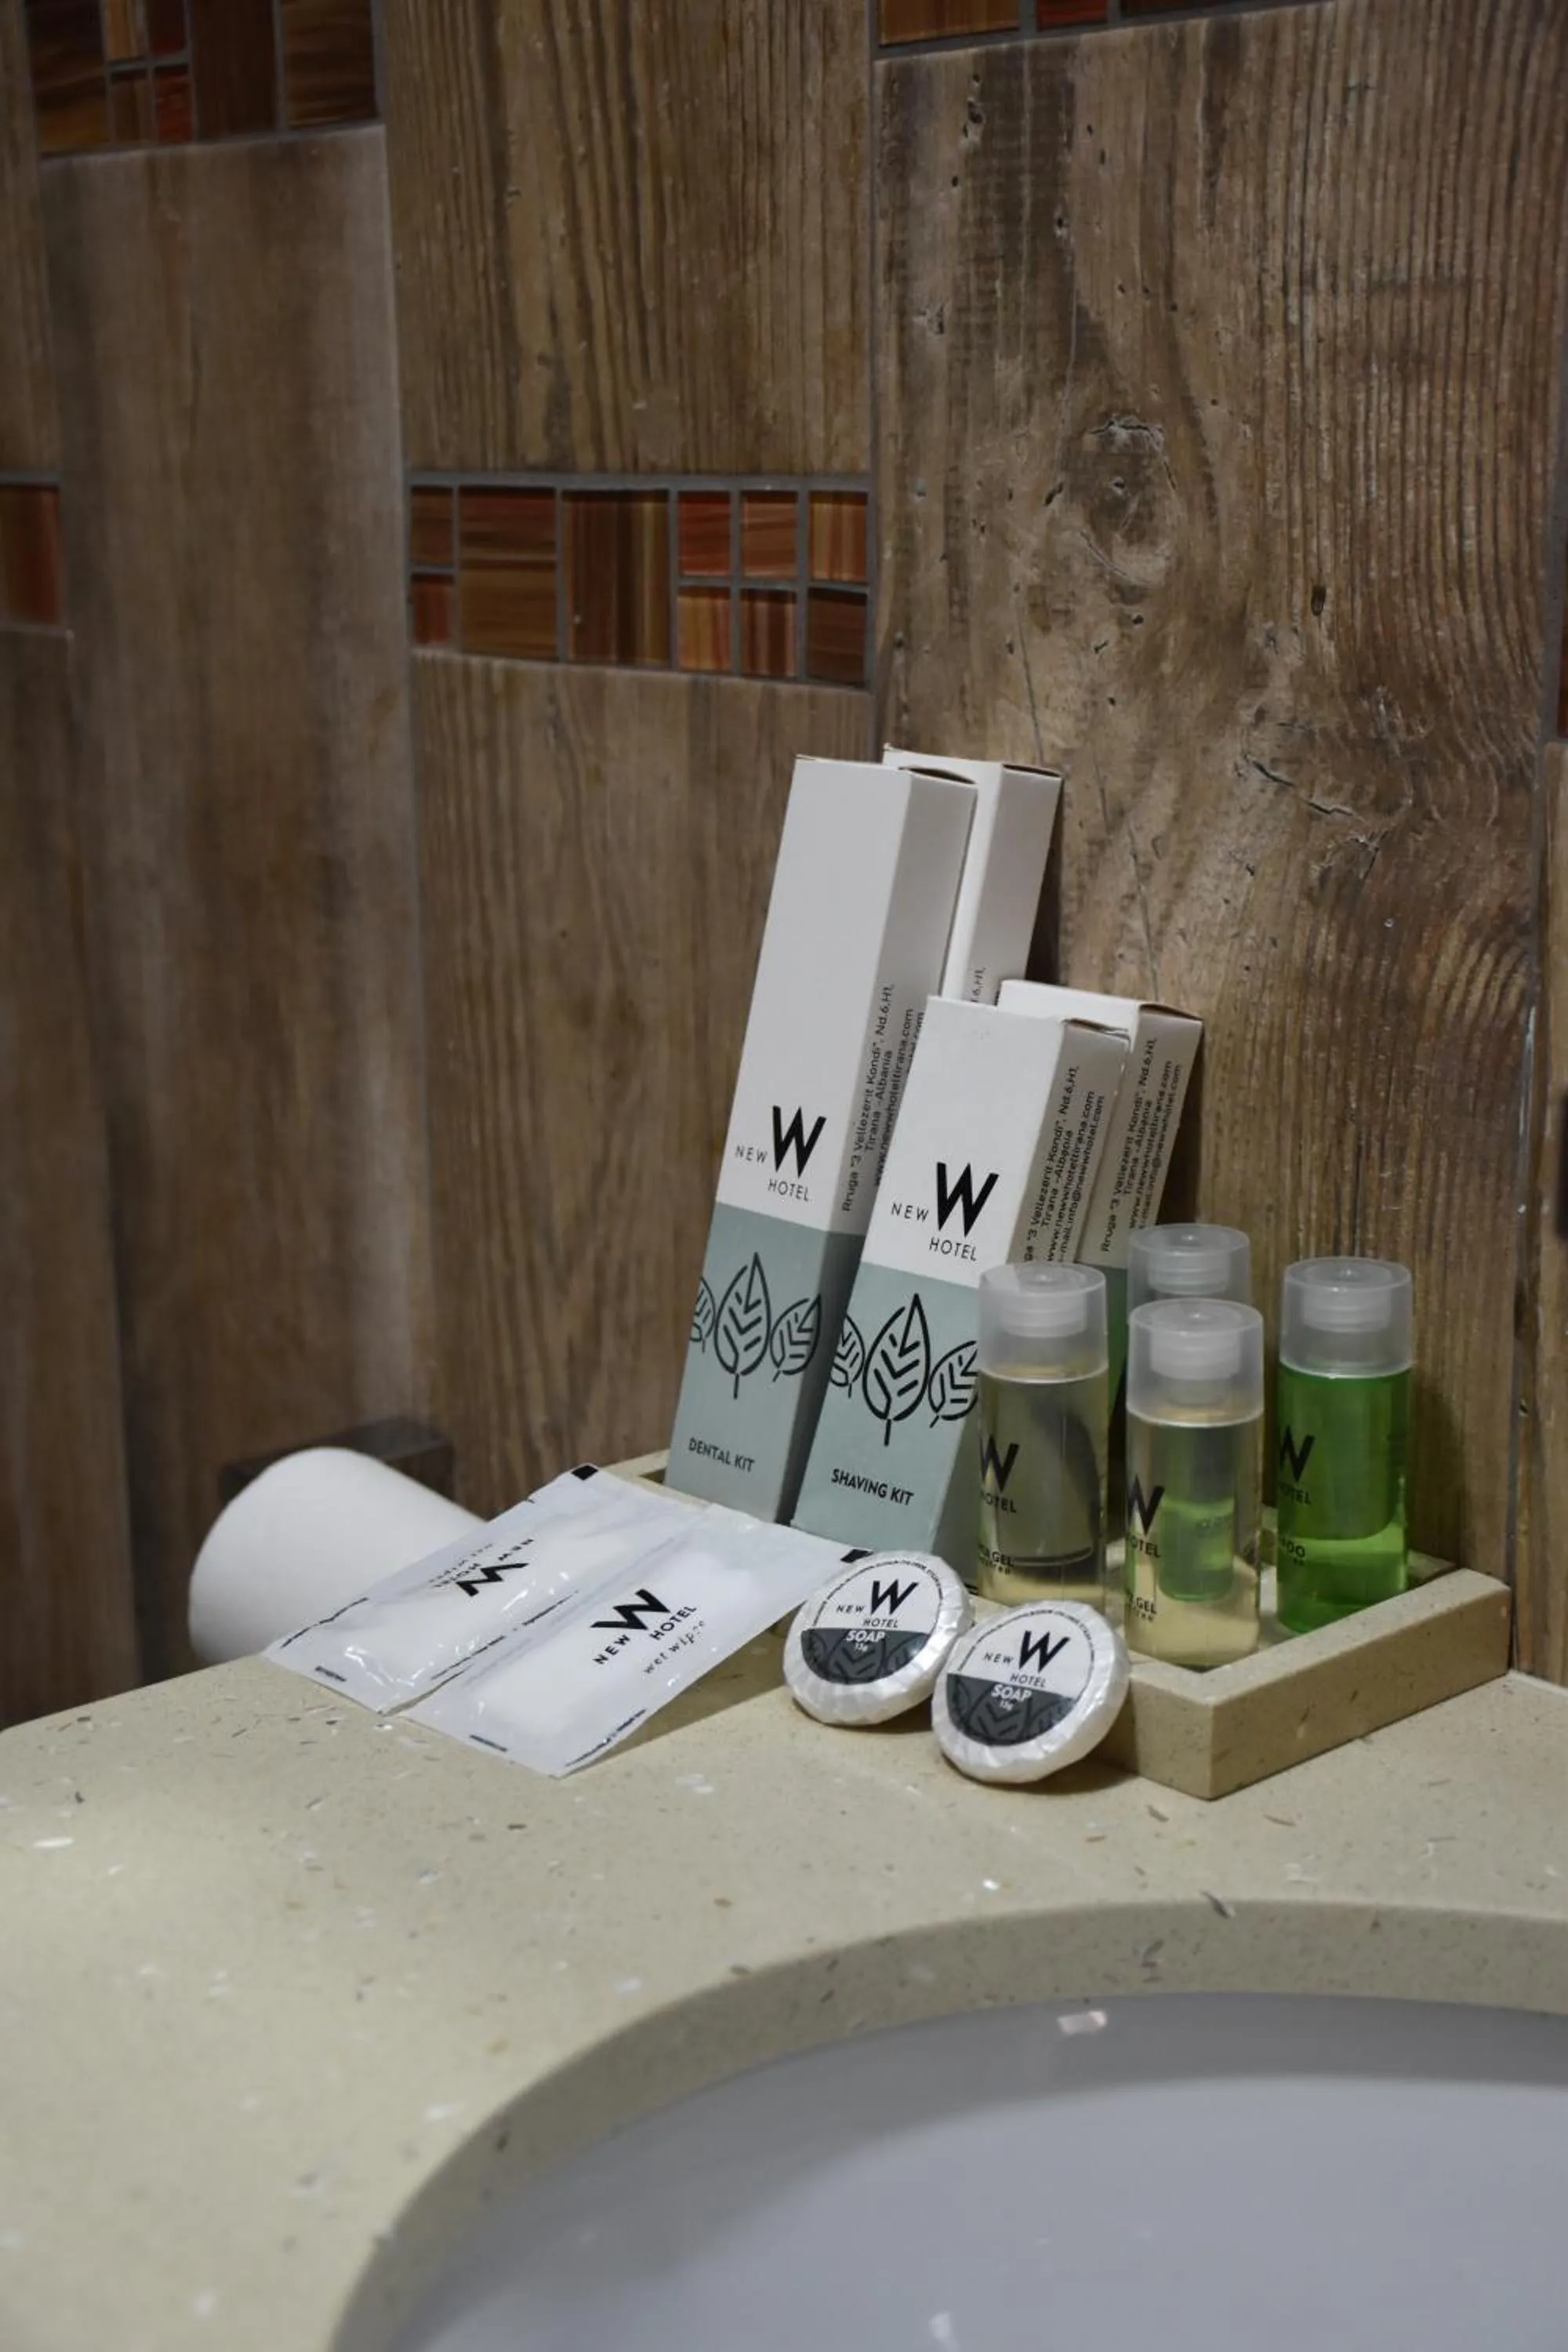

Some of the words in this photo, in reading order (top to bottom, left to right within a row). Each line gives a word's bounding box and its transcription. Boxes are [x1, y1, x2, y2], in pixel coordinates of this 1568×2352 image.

[735, 1145, 768, 1163] NEW
[772, 1105, 826, 1179] W
[864, 1110, 880, 1152] Tirana
[768, 1178, 809, 1202] HOTEL
[841, 1171, 859, 1212] Rruga
[1123, 1156, 1139, 1195] Tirana
[891, 1202, 929, 1222] NEW
[936, 1161, 1000, 1238] W
[1040, 1187, 1058, 1227] Tirana
[929, 1236, 977, 1261] HOTEL
[688, 1437, 731, 1465] DENTAL
[734, 1455, 755, 1472] KIT
[831, 1468, 887, 1498] SHAVING
[890, 1486, 915, 1506] KIT
[992, 1551, 1014, 1567] GEL
[590, 1588, 672, 1631] W
[836, 1605, 864, 1613] NEW
[870, 1578, 920, 1616] W
[1136, 1596, 1157, 1614] GEL
[649, 1606, 697, 1641] HOTEL
[846, 1630, 885, 1642] SOAP
[863, 1617, 898, 1628] HOTEL
[593, 1634, 630, 1664] NEW
[983, 1652, 1014, 1664] NEW
[1018, 1630, 1071, 1673] W
[991, 1683, 1033, 1702] SOAP
[1010, 1673, 1047, 1688] HOTEL
